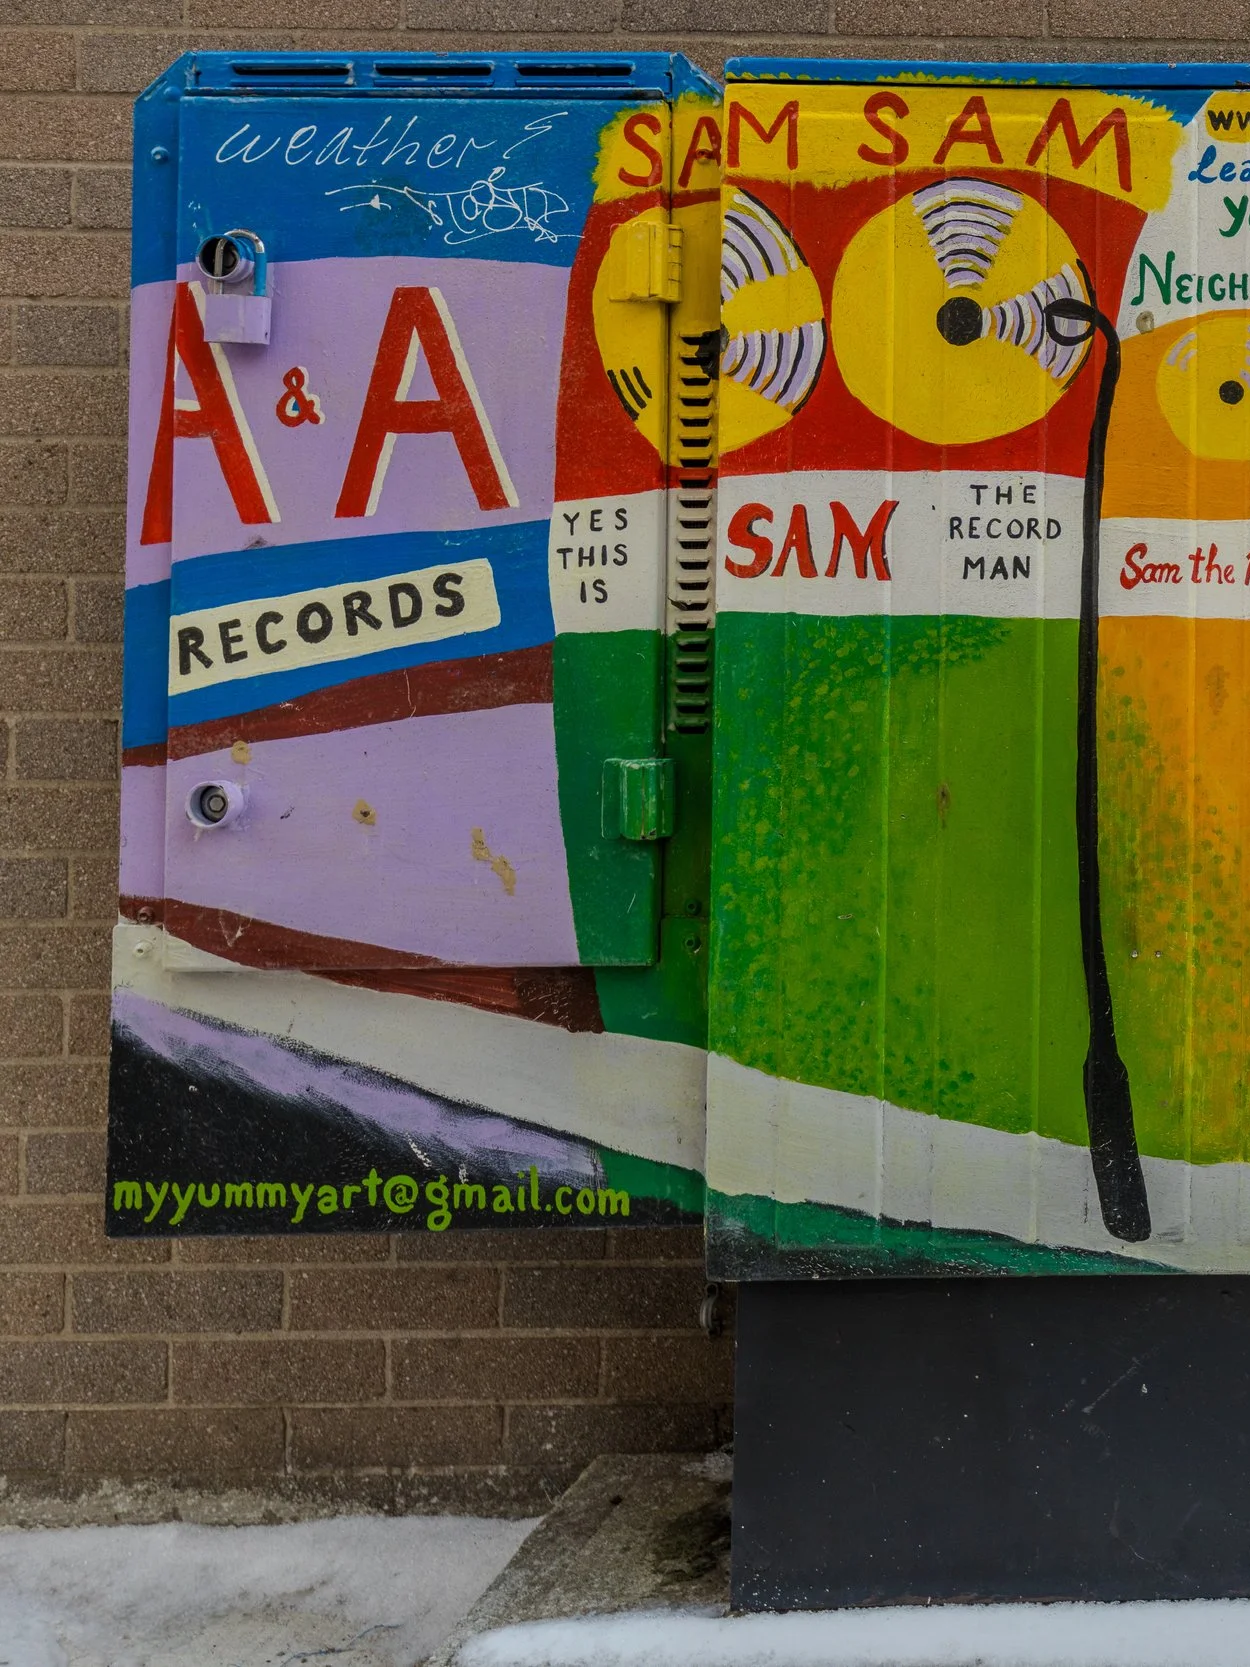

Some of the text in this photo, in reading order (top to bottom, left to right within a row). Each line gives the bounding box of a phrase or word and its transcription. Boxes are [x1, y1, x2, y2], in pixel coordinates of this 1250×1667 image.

[617, 92, 1132, 191] SAM SAM
[140, 281, 519, 545] A & A
[970, 484, 1037, 506] THE
[562, 508, 629, 535] YES
[949, 516, 1062, 541] RECORD
[556, 545, 629, 567] THIS
[724, 500, 900, 582] SAM
[962, 555, 1030, 580] MAN
[1119, 542, 1182, 590] Sam
[1188, 543, 1236, 585] the
[579, 578, 608, 604] IS
[176, 571, 467, 676] RECORDS
[112, 1165, 632, 1231] myyummyart@gmail.com
